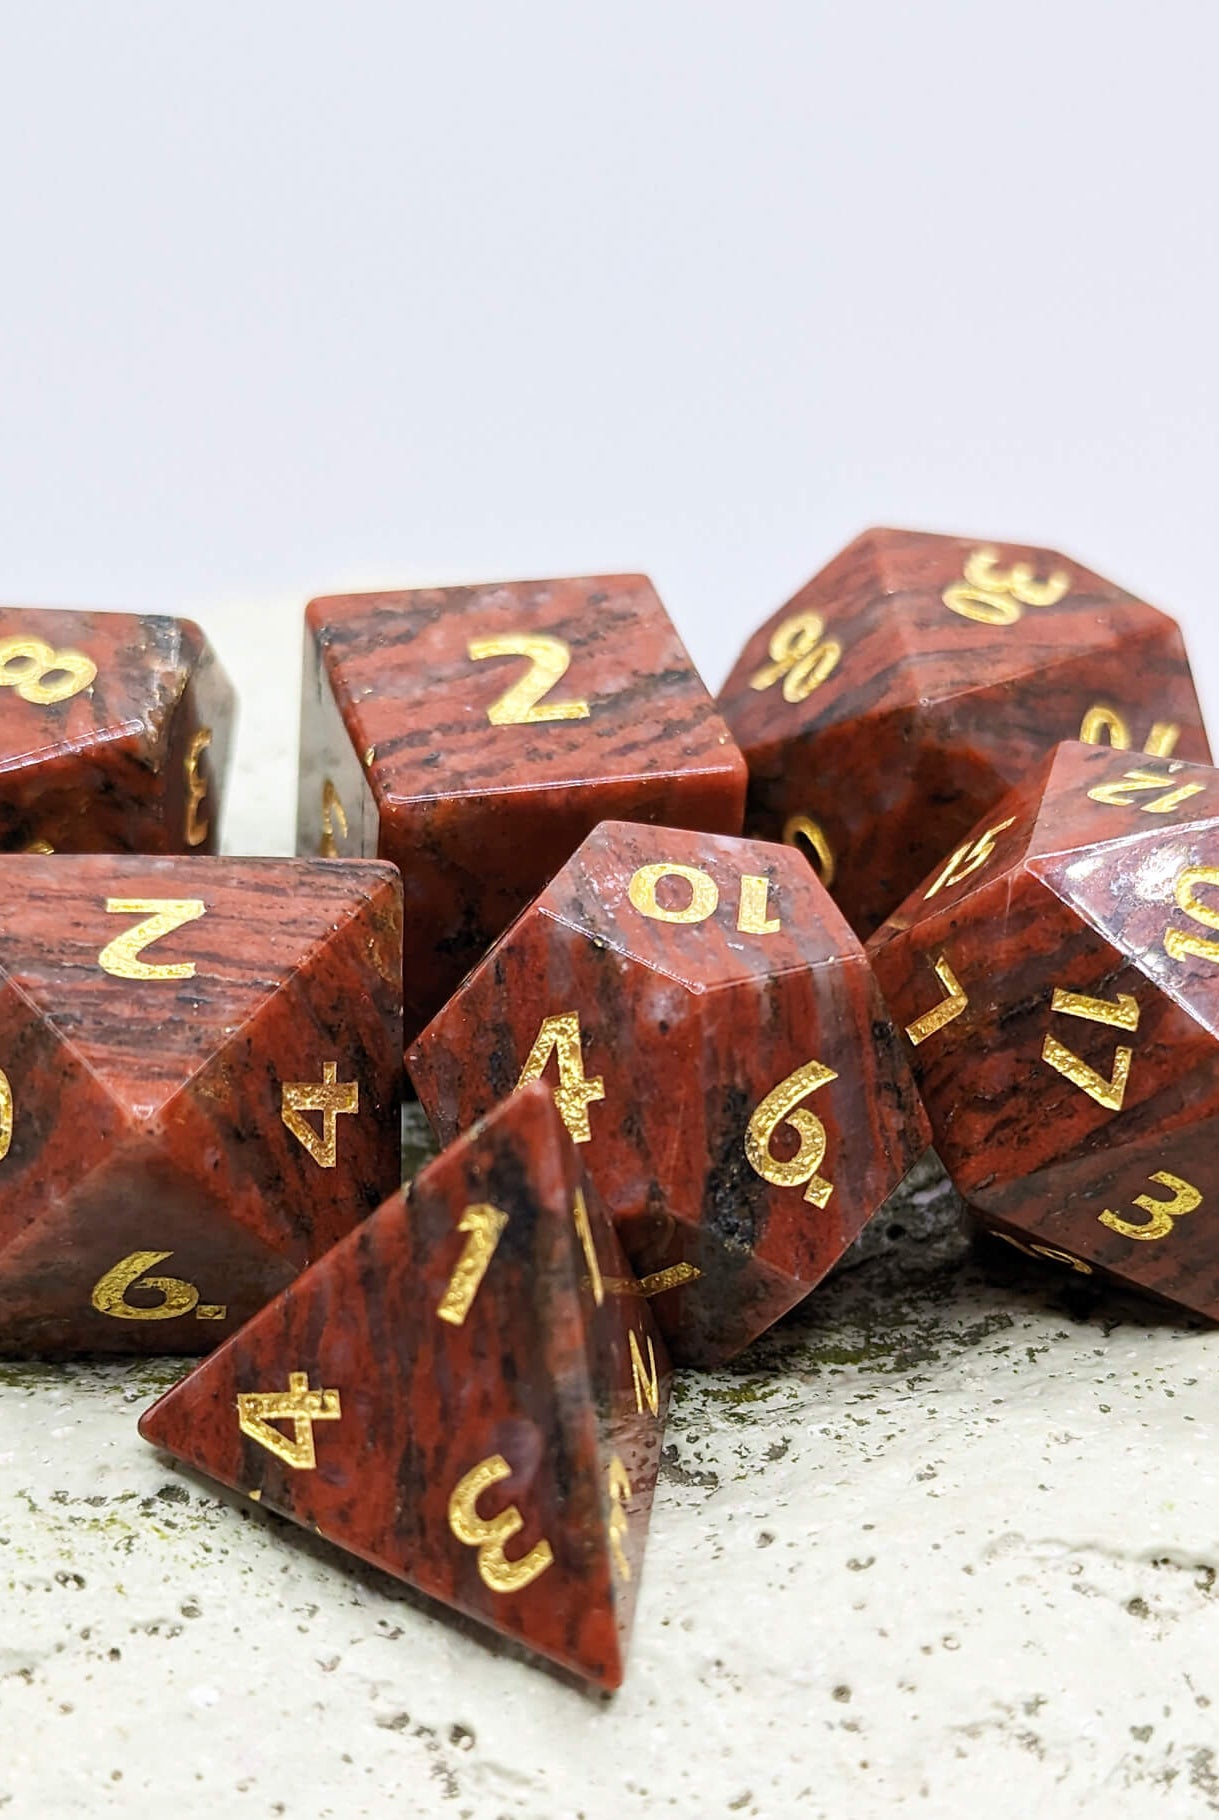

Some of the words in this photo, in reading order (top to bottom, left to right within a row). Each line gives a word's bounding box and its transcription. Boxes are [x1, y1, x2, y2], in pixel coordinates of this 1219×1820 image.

[468, 635, 591, 725] 2
[98, 898, 207, 981] 2
[627, 863, 783, 936] 10
[1041, 987, 1140, 1112] 17
[281, 1061, 359, 1169] 4
[1097, 1169, 1204, 1243] 3
[435, 1202, 510, 1327] 1
[236, 1371, 342, 1470] 4
[448, 1455, 554, 1593] 3
